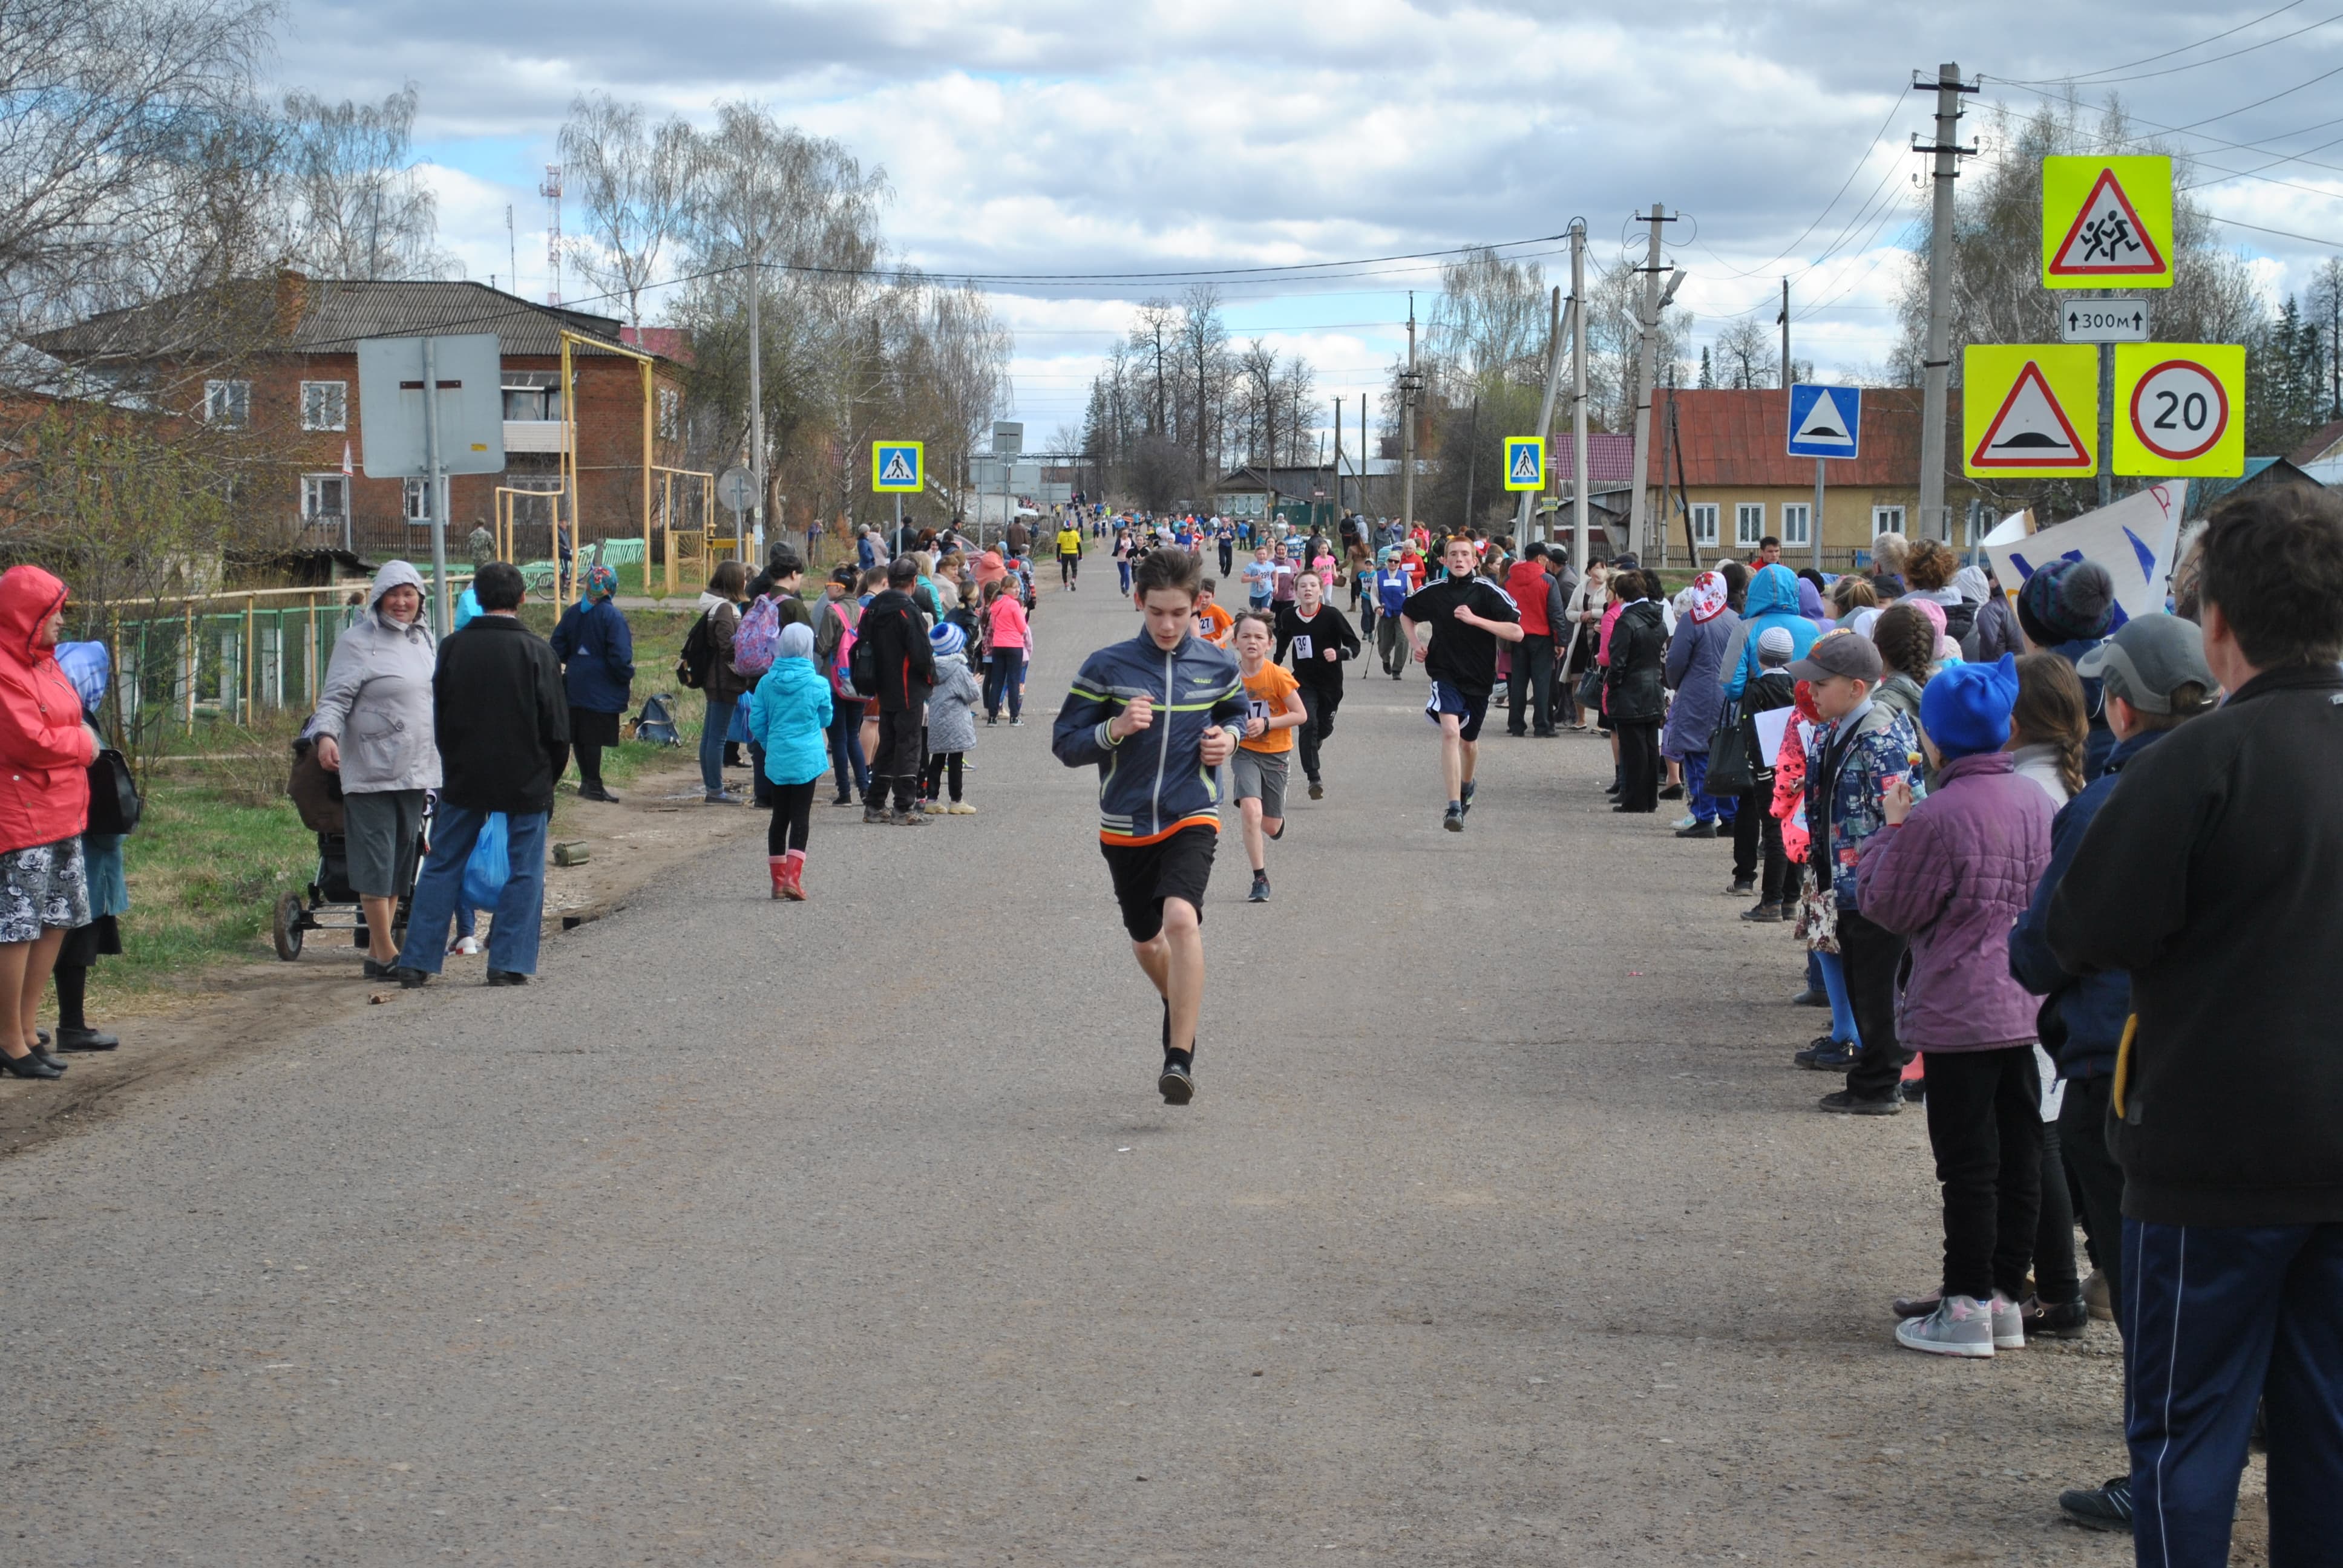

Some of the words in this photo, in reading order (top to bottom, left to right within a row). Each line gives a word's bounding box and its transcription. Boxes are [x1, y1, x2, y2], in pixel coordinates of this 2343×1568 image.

[2082, 313, 2129, 328] 300м
[2154, 390, 2207, 431] 20
[1199, 618, 1210, 630] 27
